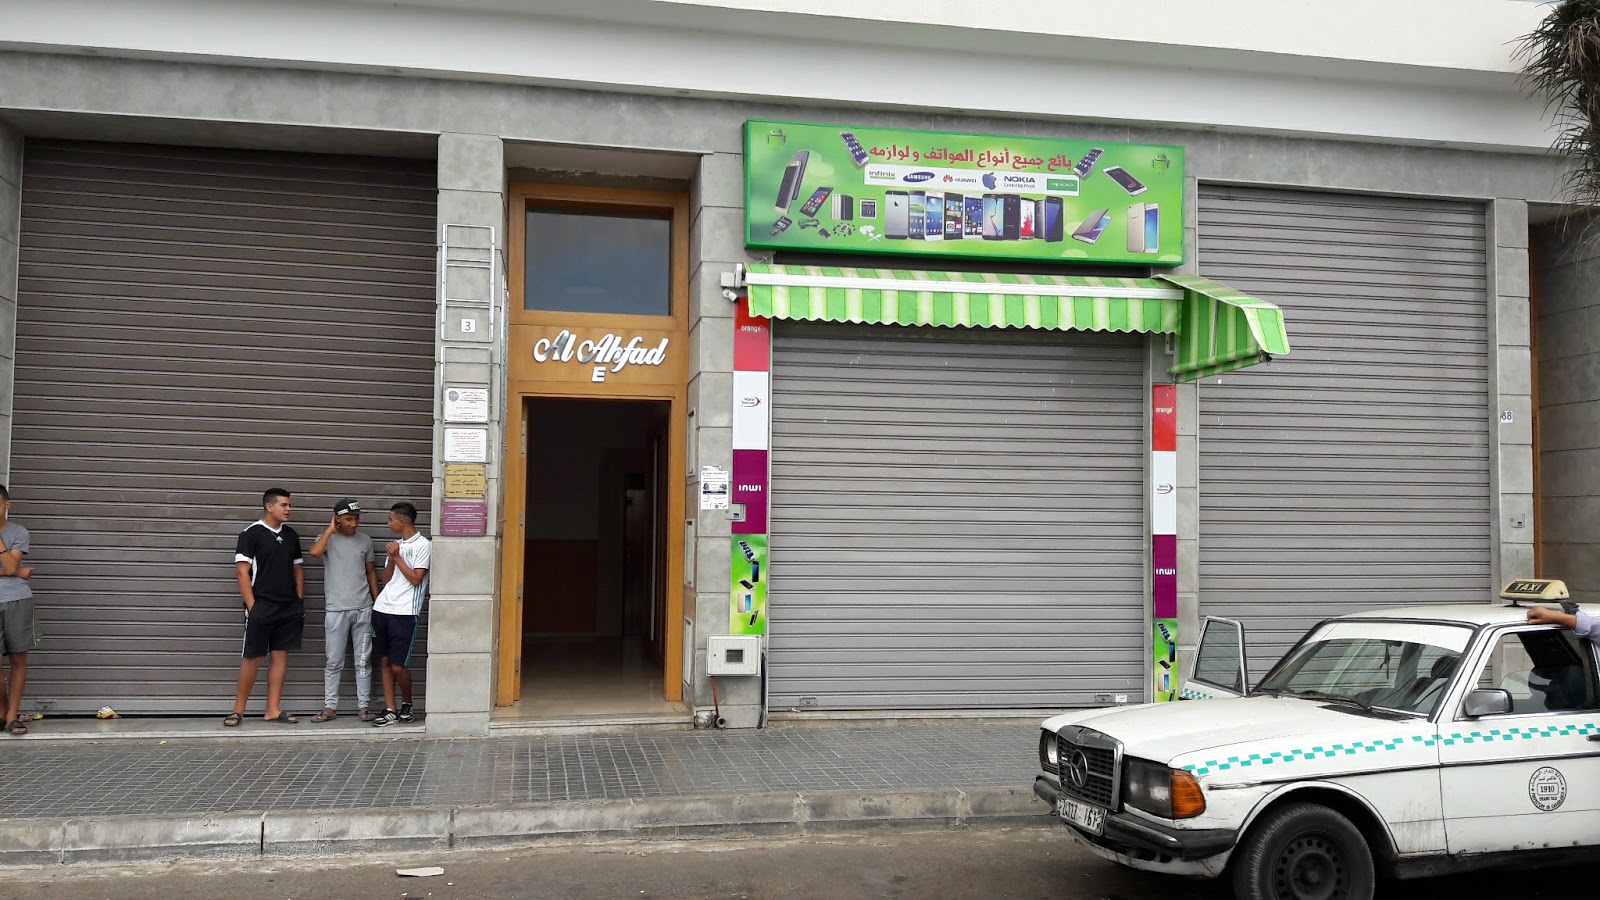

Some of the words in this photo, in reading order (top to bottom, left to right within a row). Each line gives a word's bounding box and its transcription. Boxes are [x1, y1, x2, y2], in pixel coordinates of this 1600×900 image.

[869, 144, 910, 160] لوازمه
[923, 147, 974, 164] الهواتف
[976, 146, 1010, 168] أنواع
[1012, 155, 1045, 169] جميع
[1047, 154, 1072, 172] بائع
[464, 321, 471, 331] 3
[741, 325, 761, 333] orange
[533, 329, 577, 363] Al
[576, 333, 669, 373] Ahfad
[591, 366, 607, 382] E
[1514, 583, 1542, 591] TAXI
[1540, 785, 1555, 793] 1910
